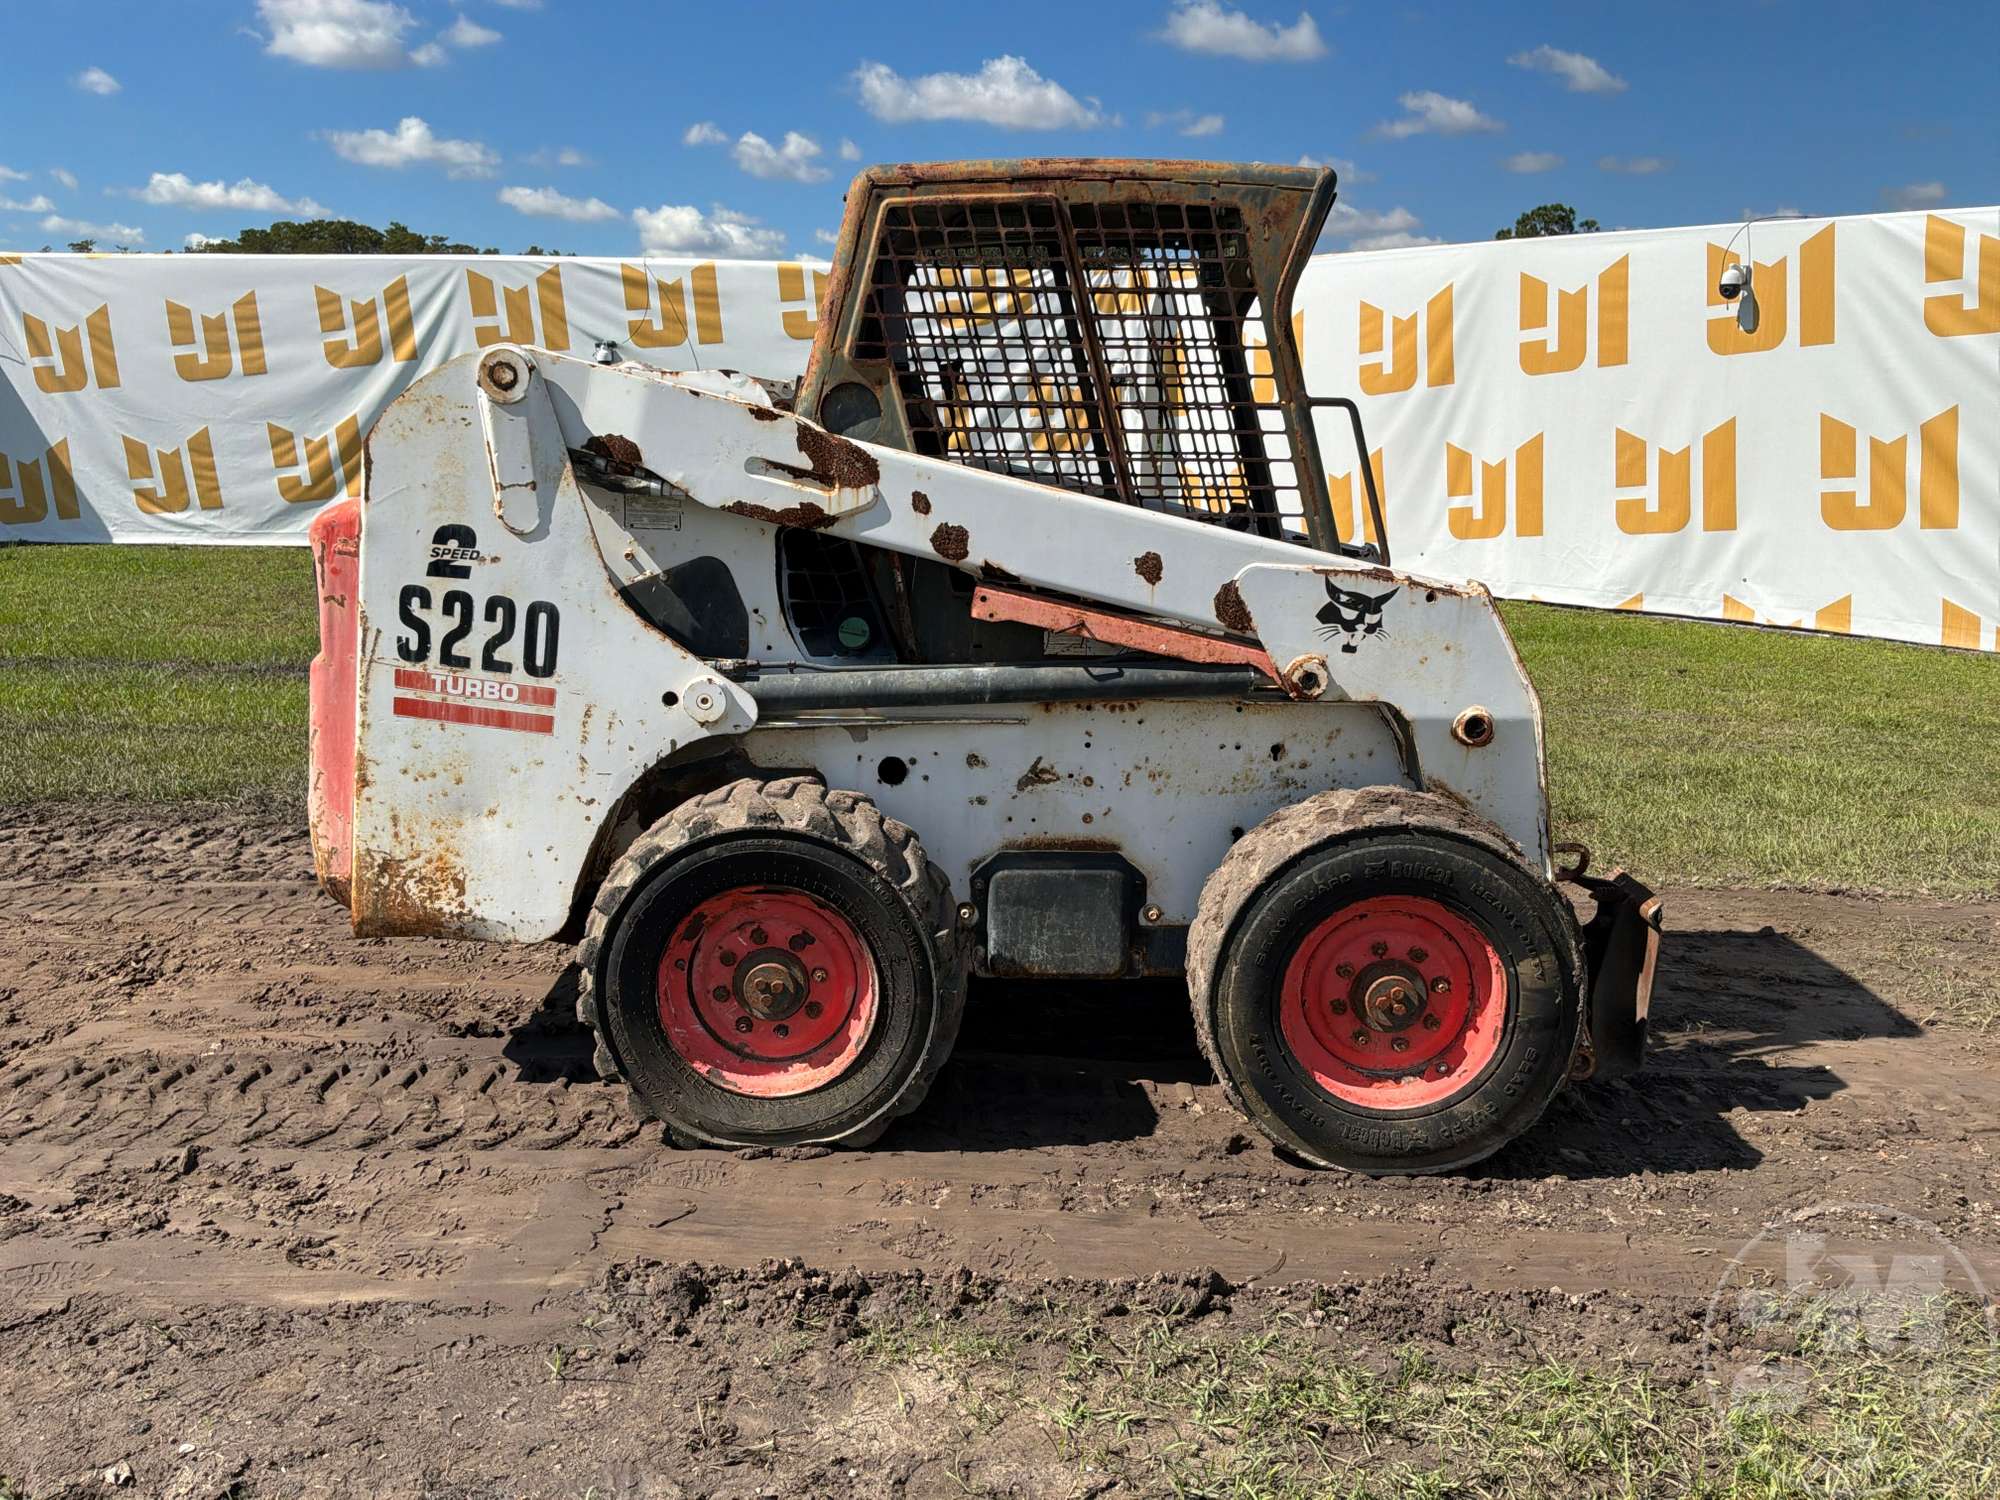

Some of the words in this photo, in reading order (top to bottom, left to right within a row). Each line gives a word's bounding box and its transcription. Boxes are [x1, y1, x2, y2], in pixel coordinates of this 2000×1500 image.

[426, 524, 477, 579] 2
[430, 547, 480, 561] SPEED
[397, 585, 560, 678] S220
[431, 674, 519, 700] TURBO
